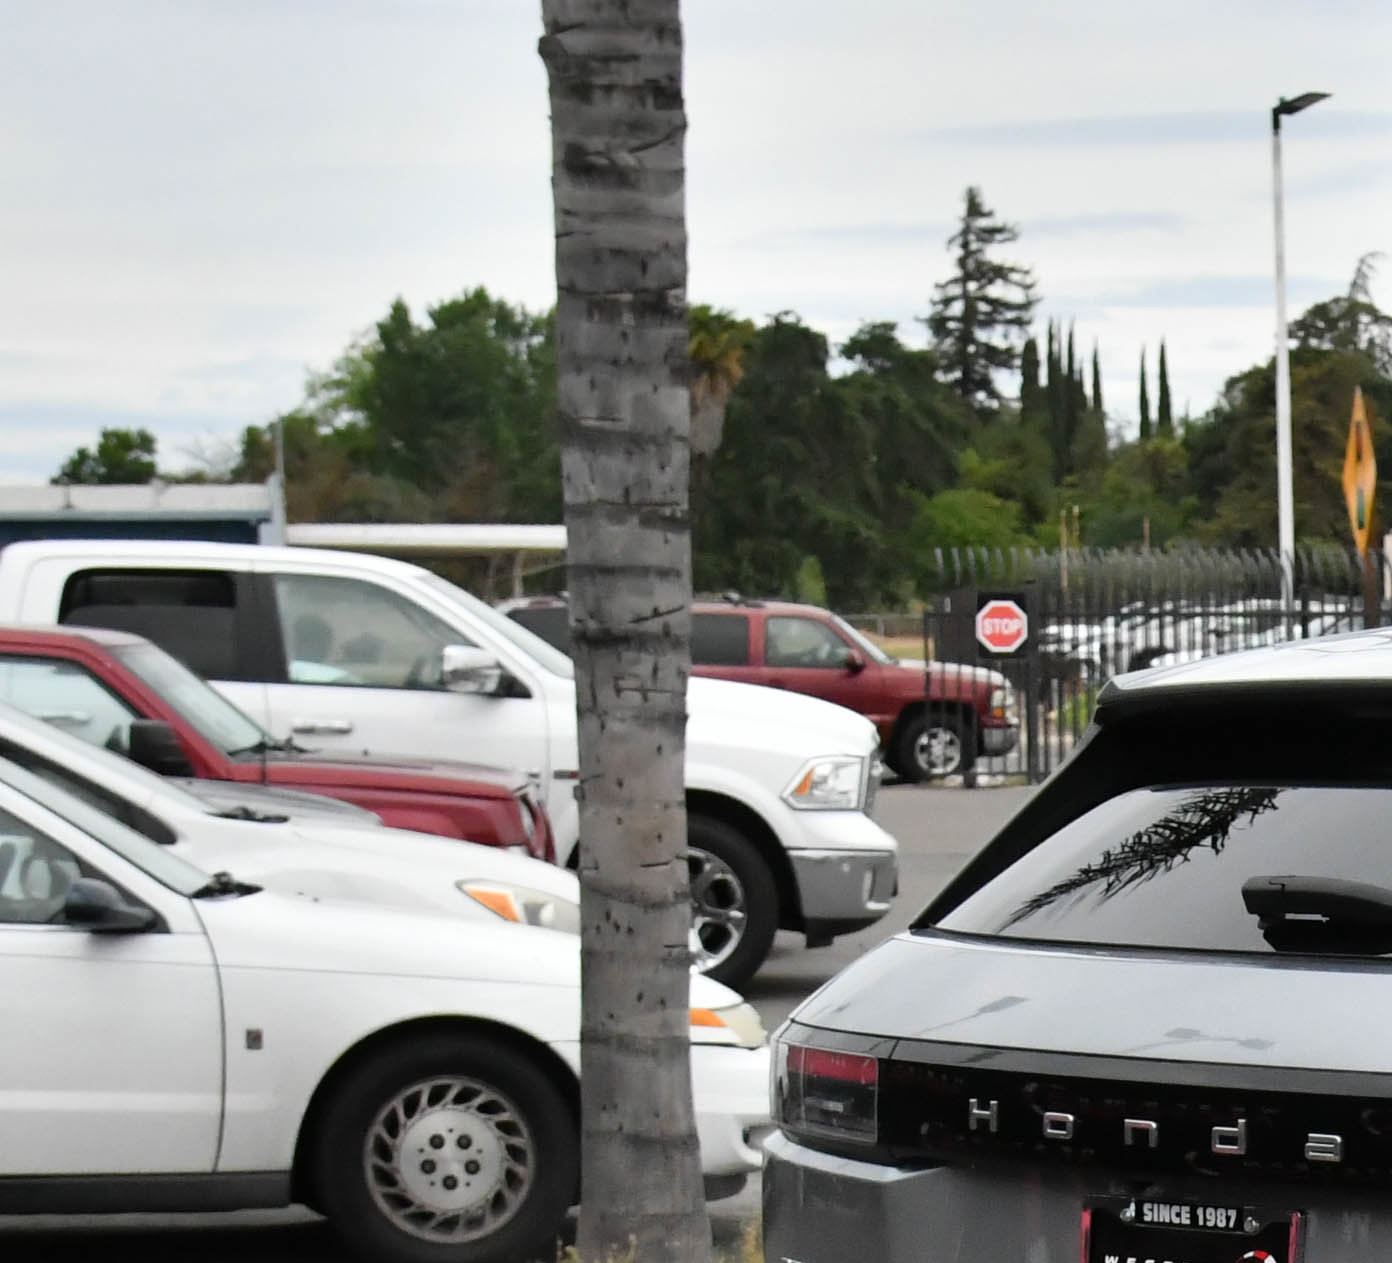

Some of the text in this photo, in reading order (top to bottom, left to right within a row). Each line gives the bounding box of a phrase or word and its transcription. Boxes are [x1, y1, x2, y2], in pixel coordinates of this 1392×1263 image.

[983, 618, 1023, 635] STOP
[1143, 1203, 1237, 1228] SINCE 1987
